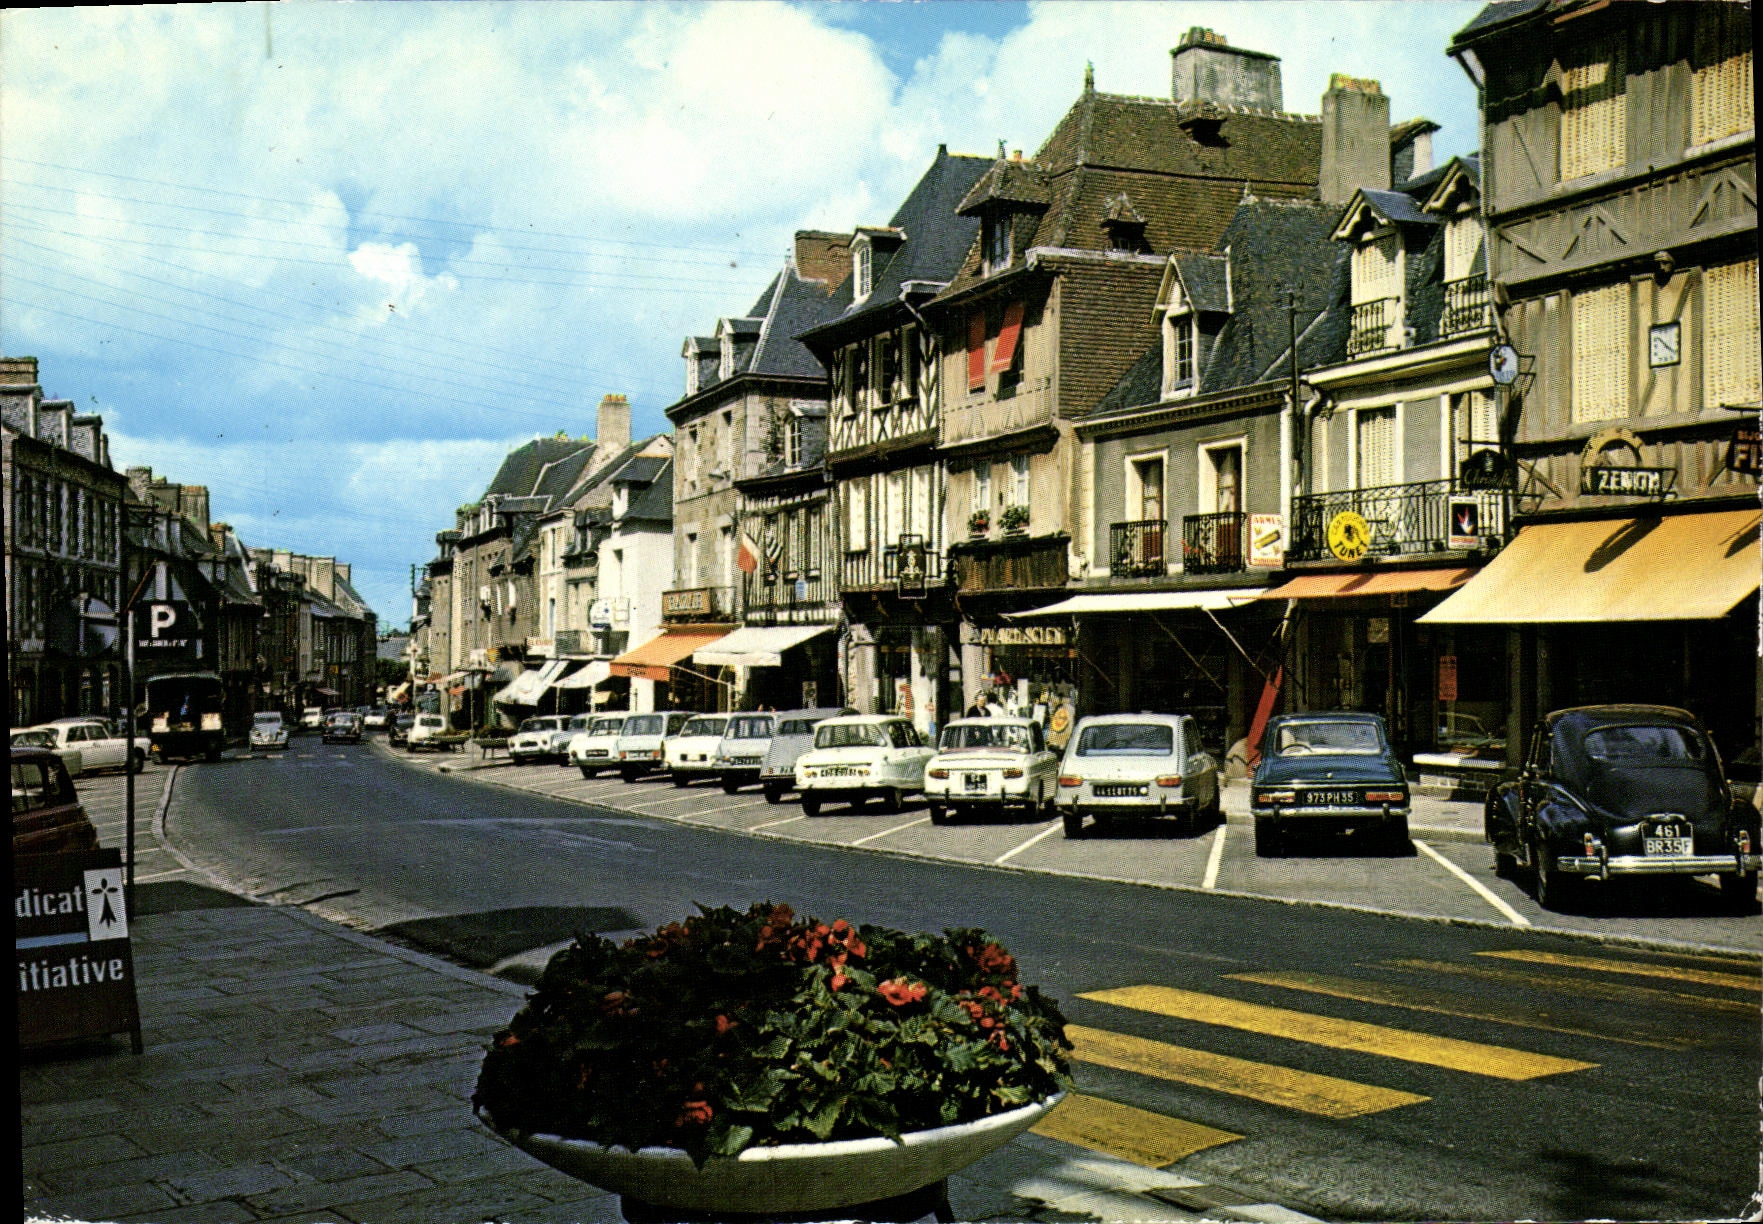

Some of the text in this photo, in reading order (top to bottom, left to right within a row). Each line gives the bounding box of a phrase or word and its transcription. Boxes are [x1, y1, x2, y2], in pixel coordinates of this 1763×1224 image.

[1598, 470, 1660, 494] ZENITH
[1253, 516, 1282, 525] ARMES
[1334, 540, 1368, 559] TUNET
[151, 604, 176, 638] P
[1655, 824, 1680, 837] 461
[15, 885, 84, 918] dicat
[19, 955, 124, 992] itiative
